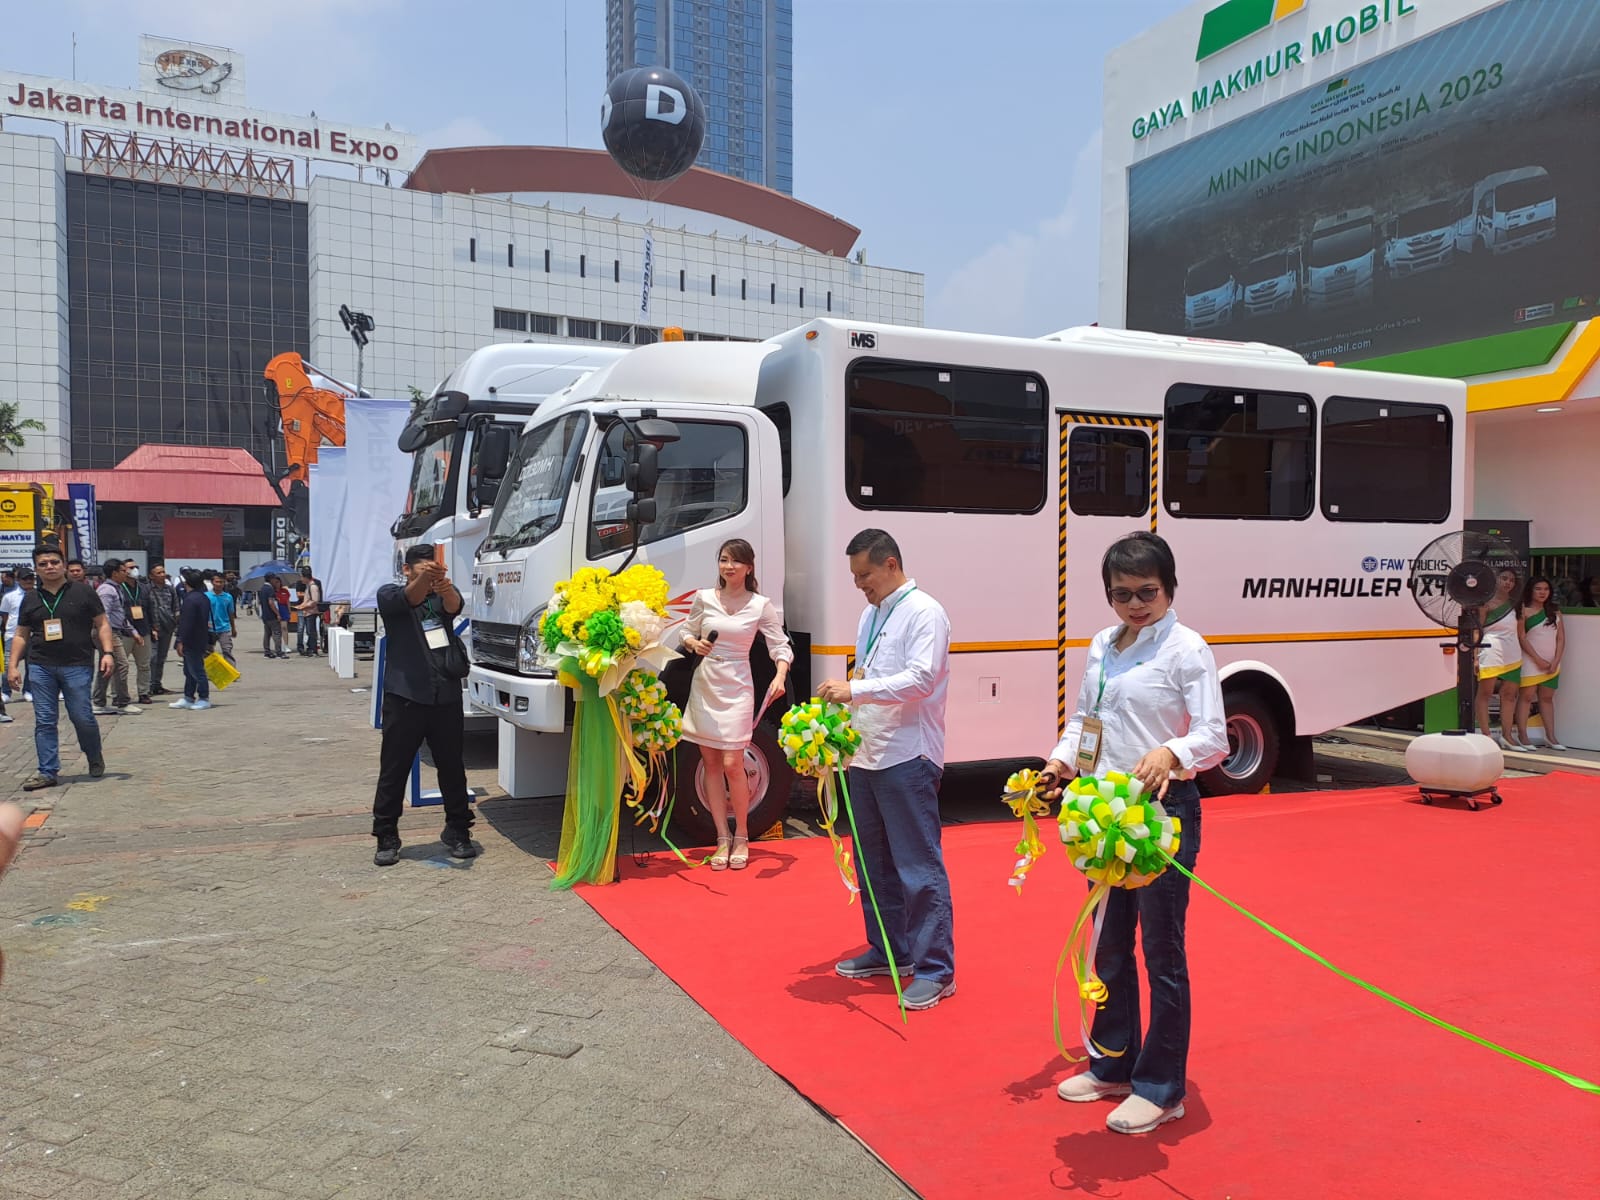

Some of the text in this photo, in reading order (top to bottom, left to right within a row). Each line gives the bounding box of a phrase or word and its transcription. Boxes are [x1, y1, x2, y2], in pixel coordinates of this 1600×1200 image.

[645, 84, 687, 126] D
[1131, 99, 1185, 141] GAYA
[1190, 42, 1303, 111] MAKMUR
[1311, 0, 1415, 58] MOBIL
[7, 82, 399, 162] Jakarta International Expo
[1207, 145, 1291, 198] MINING
[1294, 93, 1432, 162] INDONESIA
[1438, 62, 1504, 110] 2023
[640, 239, 653, 313] DEVELON
[1242, 578, 1402, 599] MANHAULER
[1380, 558, 1448, 571] FAW TRUCKS
